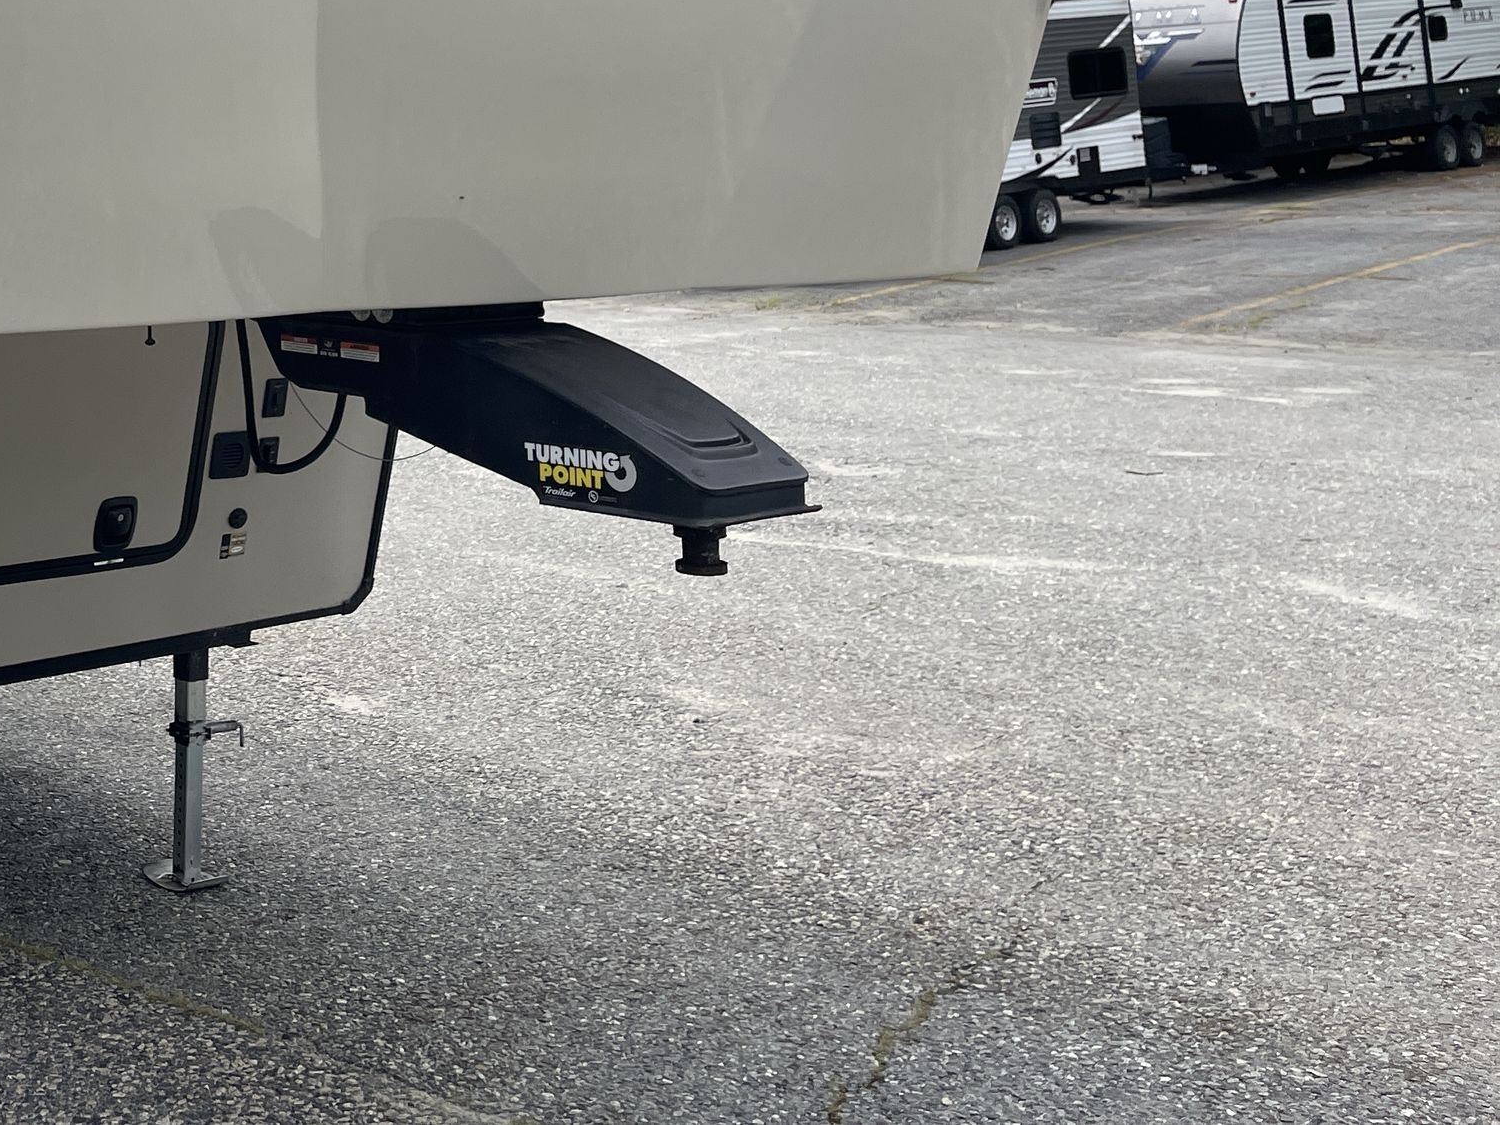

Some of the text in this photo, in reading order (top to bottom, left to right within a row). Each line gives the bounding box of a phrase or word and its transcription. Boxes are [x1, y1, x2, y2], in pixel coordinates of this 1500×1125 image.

[524, 442, 620, 472] TURNING
[540, 463, 604, 490] POINT
[542, 485, 576, 497] Trailair
